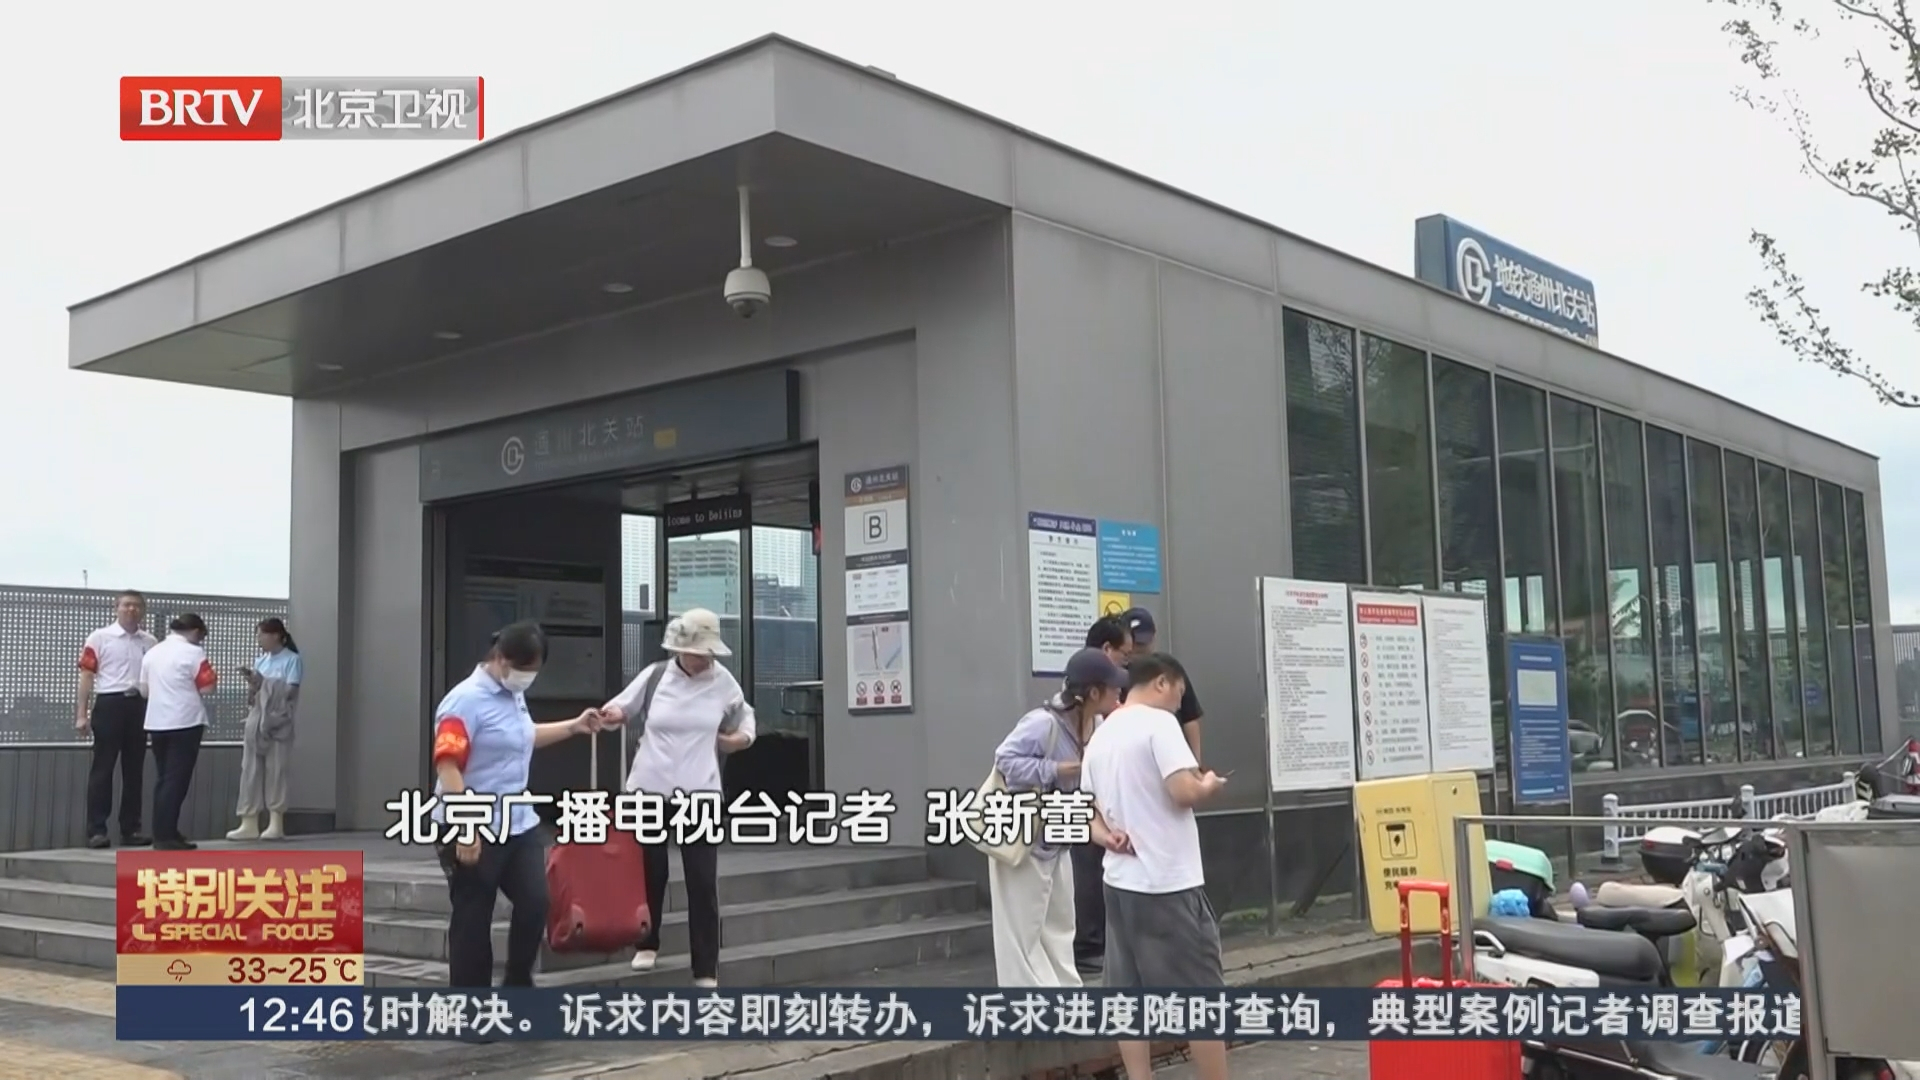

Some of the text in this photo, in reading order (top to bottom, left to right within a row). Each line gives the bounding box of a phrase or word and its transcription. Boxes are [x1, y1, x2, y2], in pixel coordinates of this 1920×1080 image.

[1493, 254, 1596, 328] 地铁通州北关站
[869, 515, 882, 539] B
